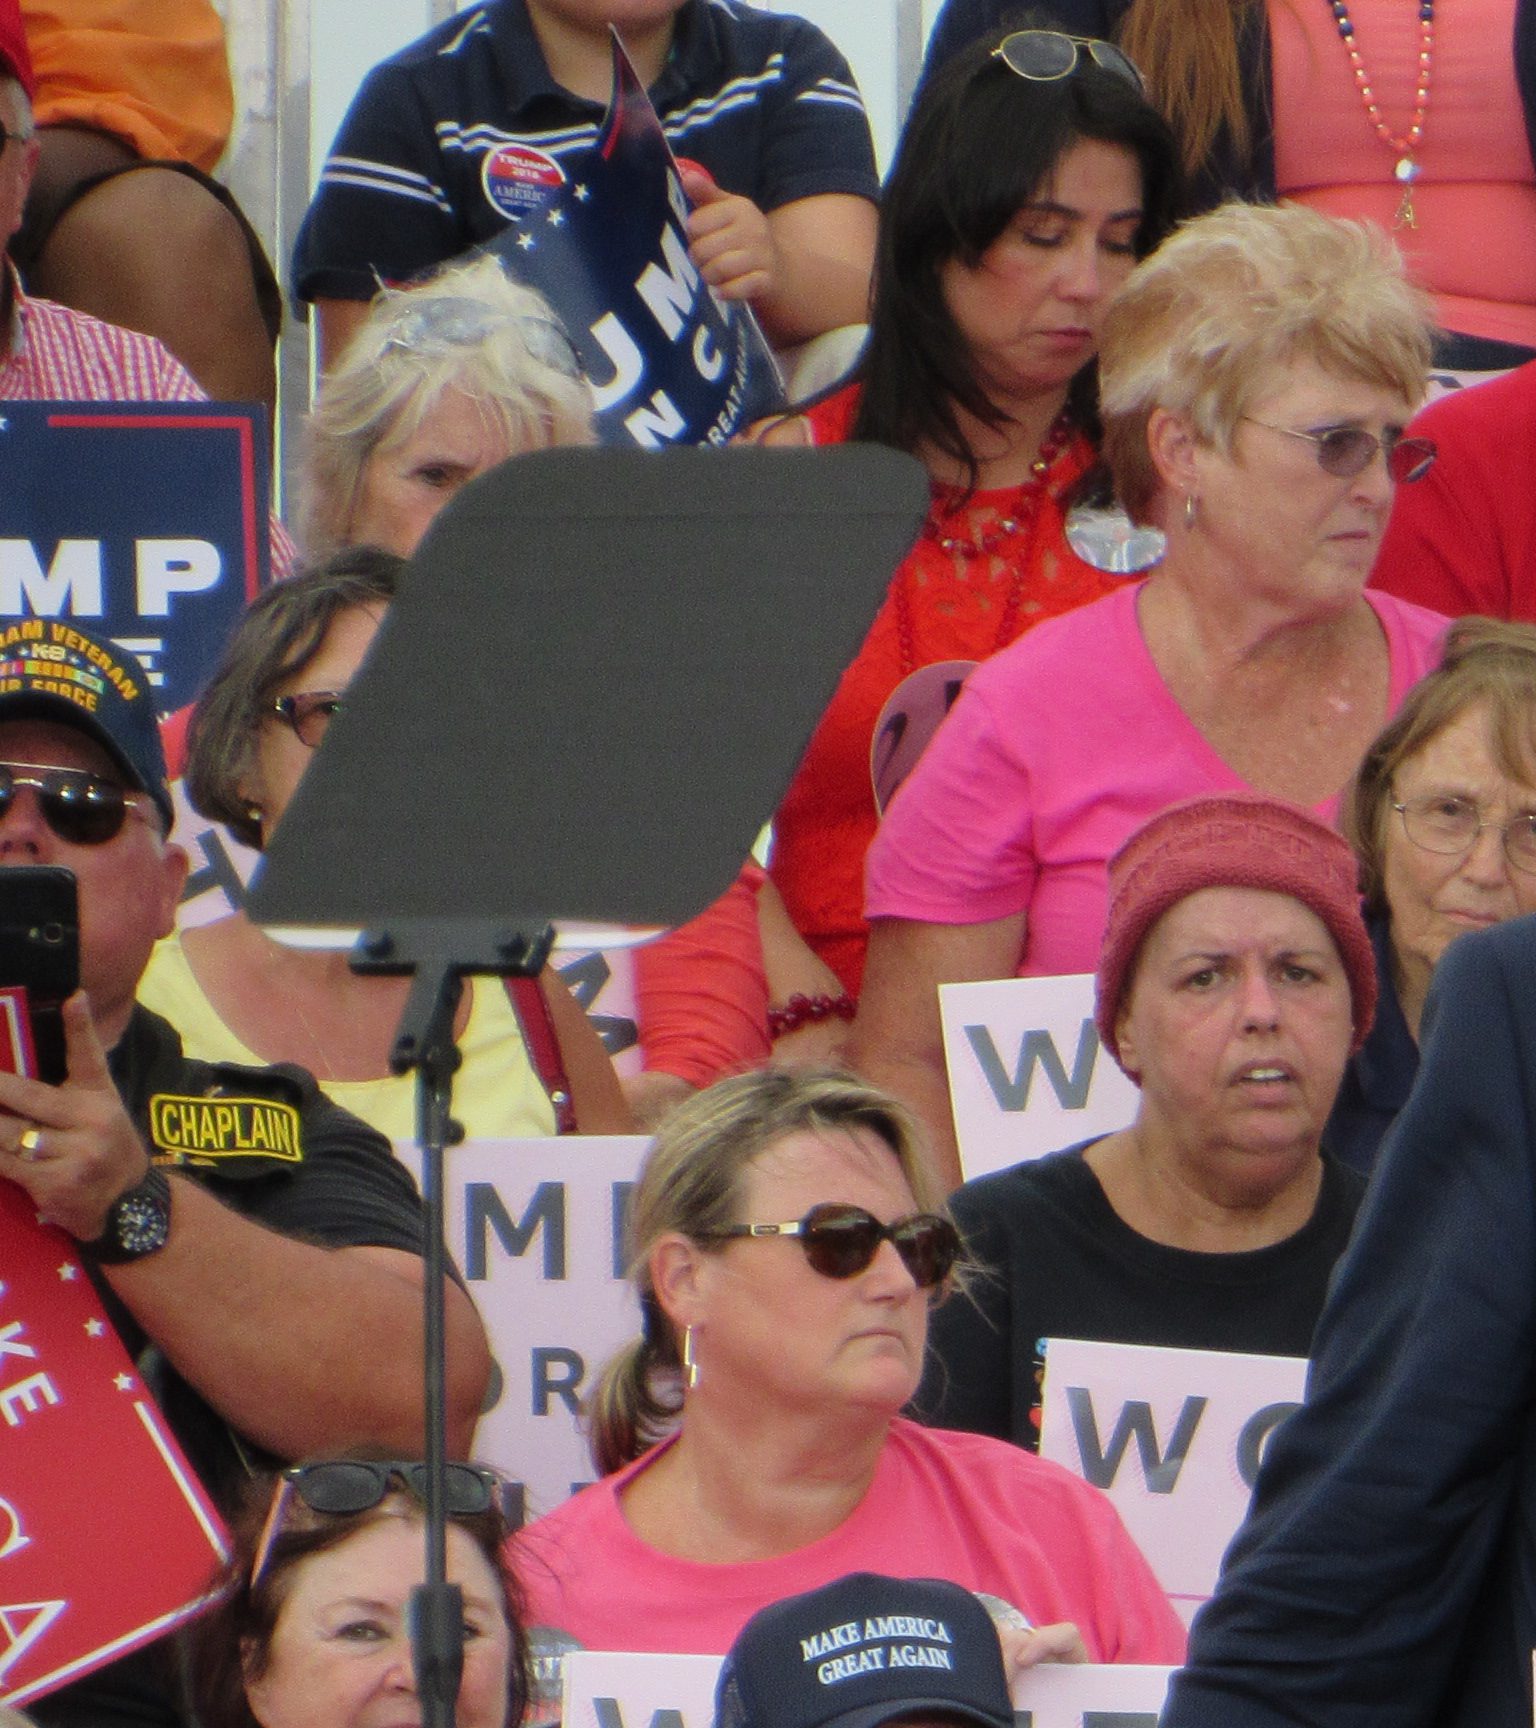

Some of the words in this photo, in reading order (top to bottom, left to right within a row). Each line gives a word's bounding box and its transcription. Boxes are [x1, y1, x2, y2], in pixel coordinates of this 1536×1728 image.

[51, 621, 140, 702] VETERAN
[161, 1102, 294, 1155] CHAPLAIN
[800, 1621, 861, 1663] MAKE
[863, 1615, 953, 1645] AMERICA
[817, 1647, 885, 1686] GREAT
[888, 1644, 952, 1671] AGAIN
